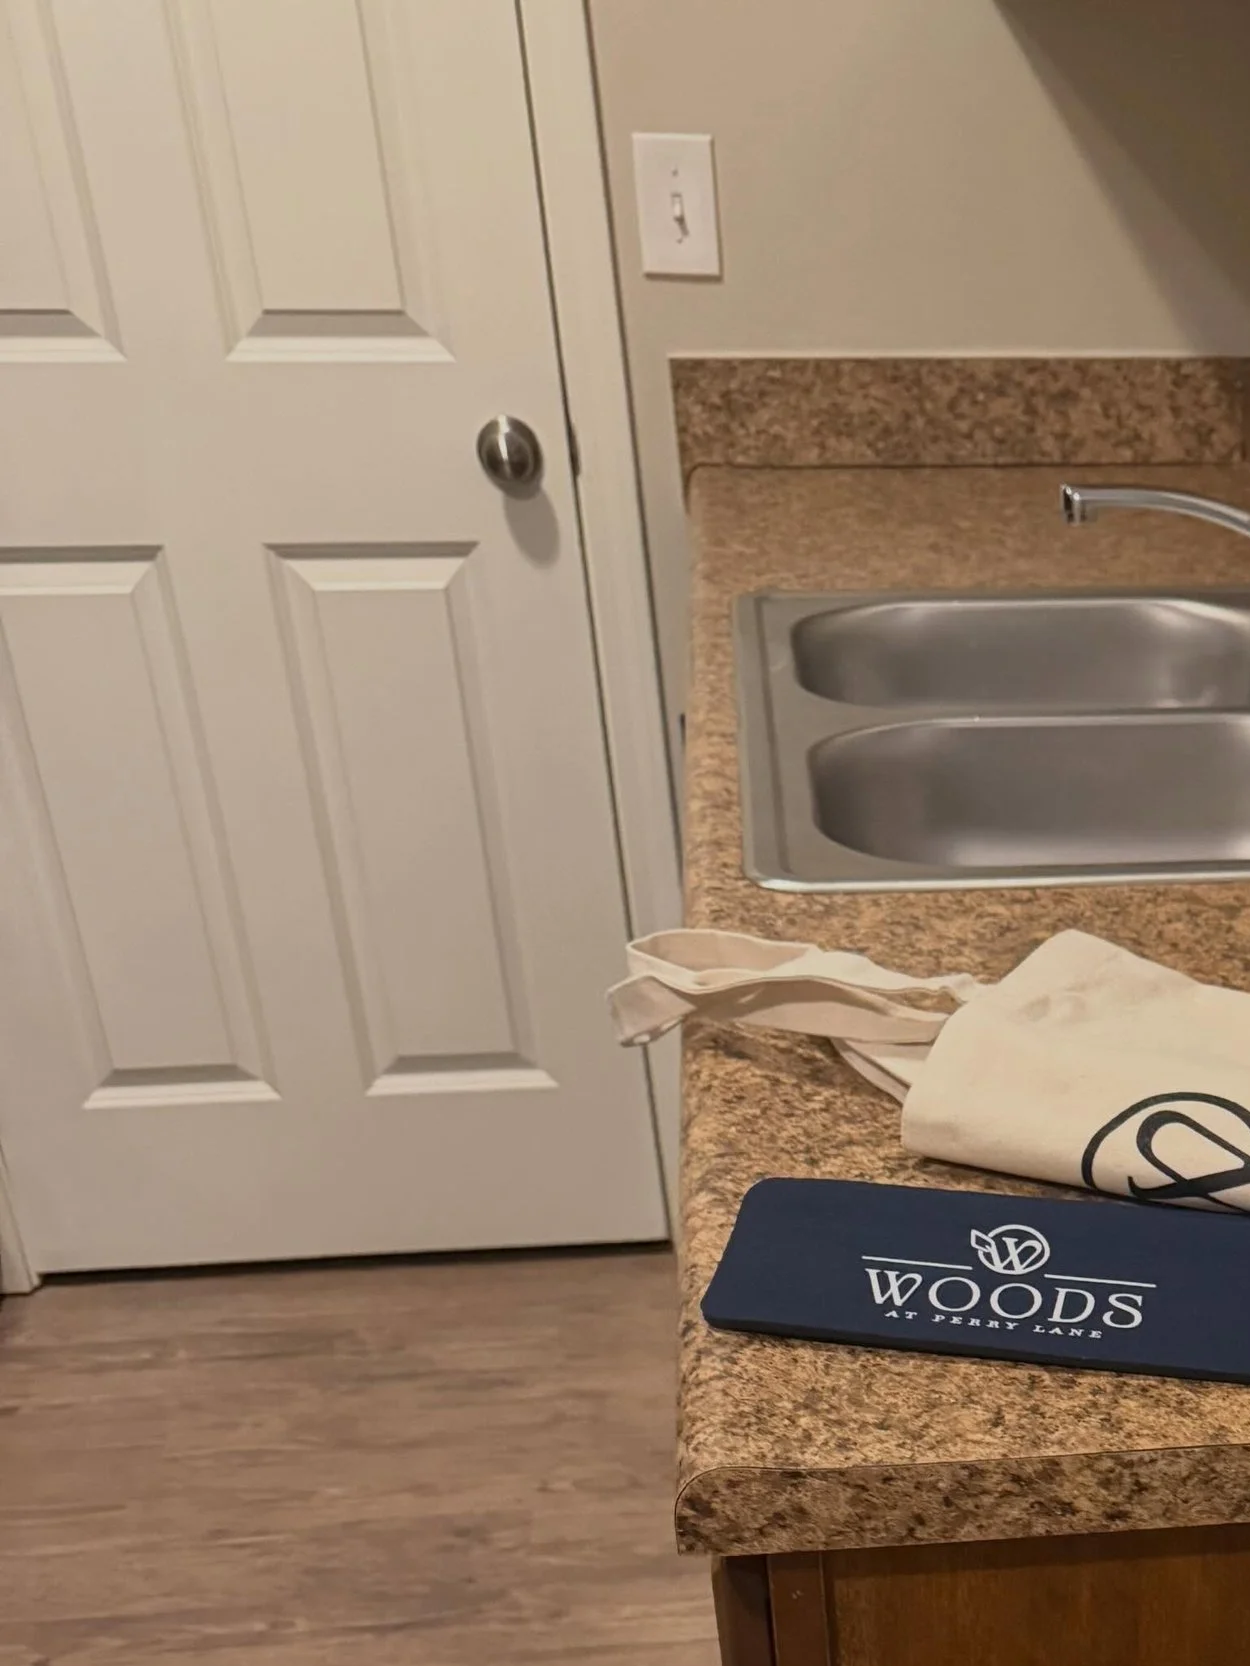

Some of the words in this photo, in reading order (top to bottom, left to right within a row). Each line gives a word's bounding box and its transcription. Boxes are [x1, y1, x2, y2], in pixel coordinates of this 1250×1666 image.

[865, 1268, 1143, 1329] WOODS
[884, 1309, 919, 1320] AT
[932, 1314, 1021, 1331] PERRY
[1033, 1324, 1103, 1339] LANE
